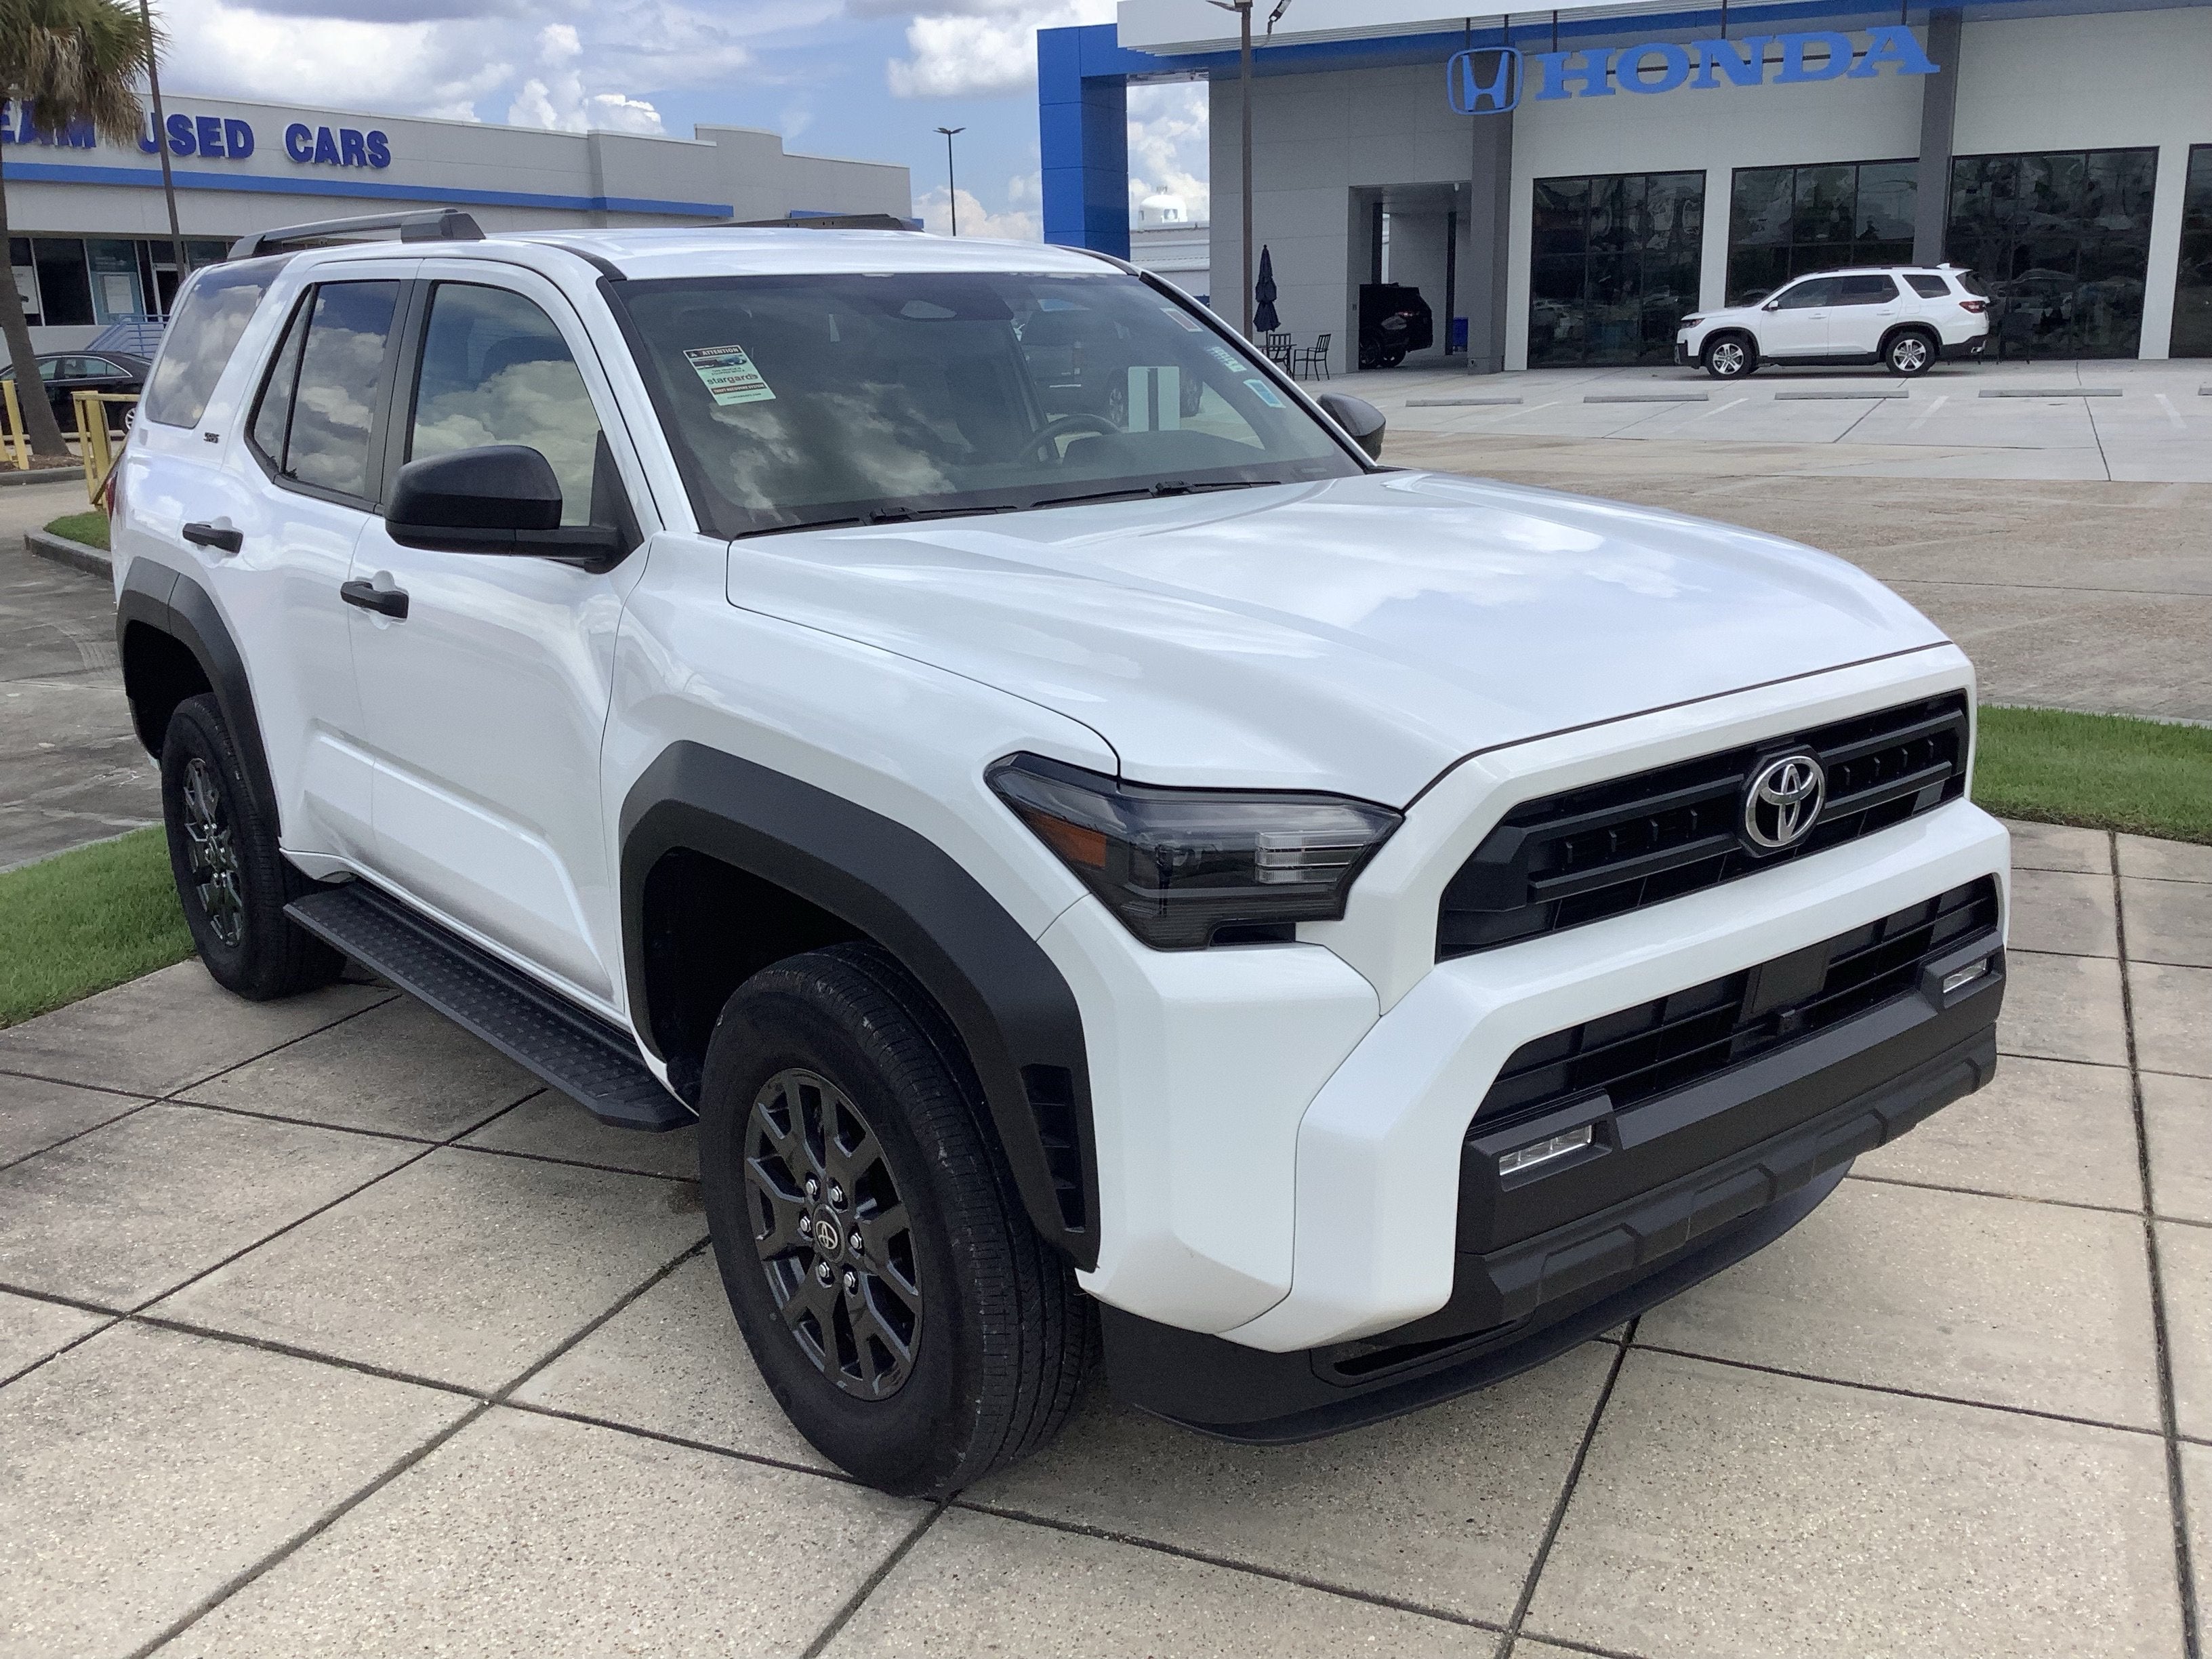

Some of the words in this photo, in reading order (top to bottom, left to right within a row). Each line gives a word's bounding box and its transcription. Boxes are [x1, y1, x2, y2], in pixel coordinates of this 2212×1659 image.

[1535, 24, 1940, 100] HONDA
[139, 112, 254, 159] USED
[285, 123, 391, 168] CARS
[701, 347, 739, 356] ATTENTION
